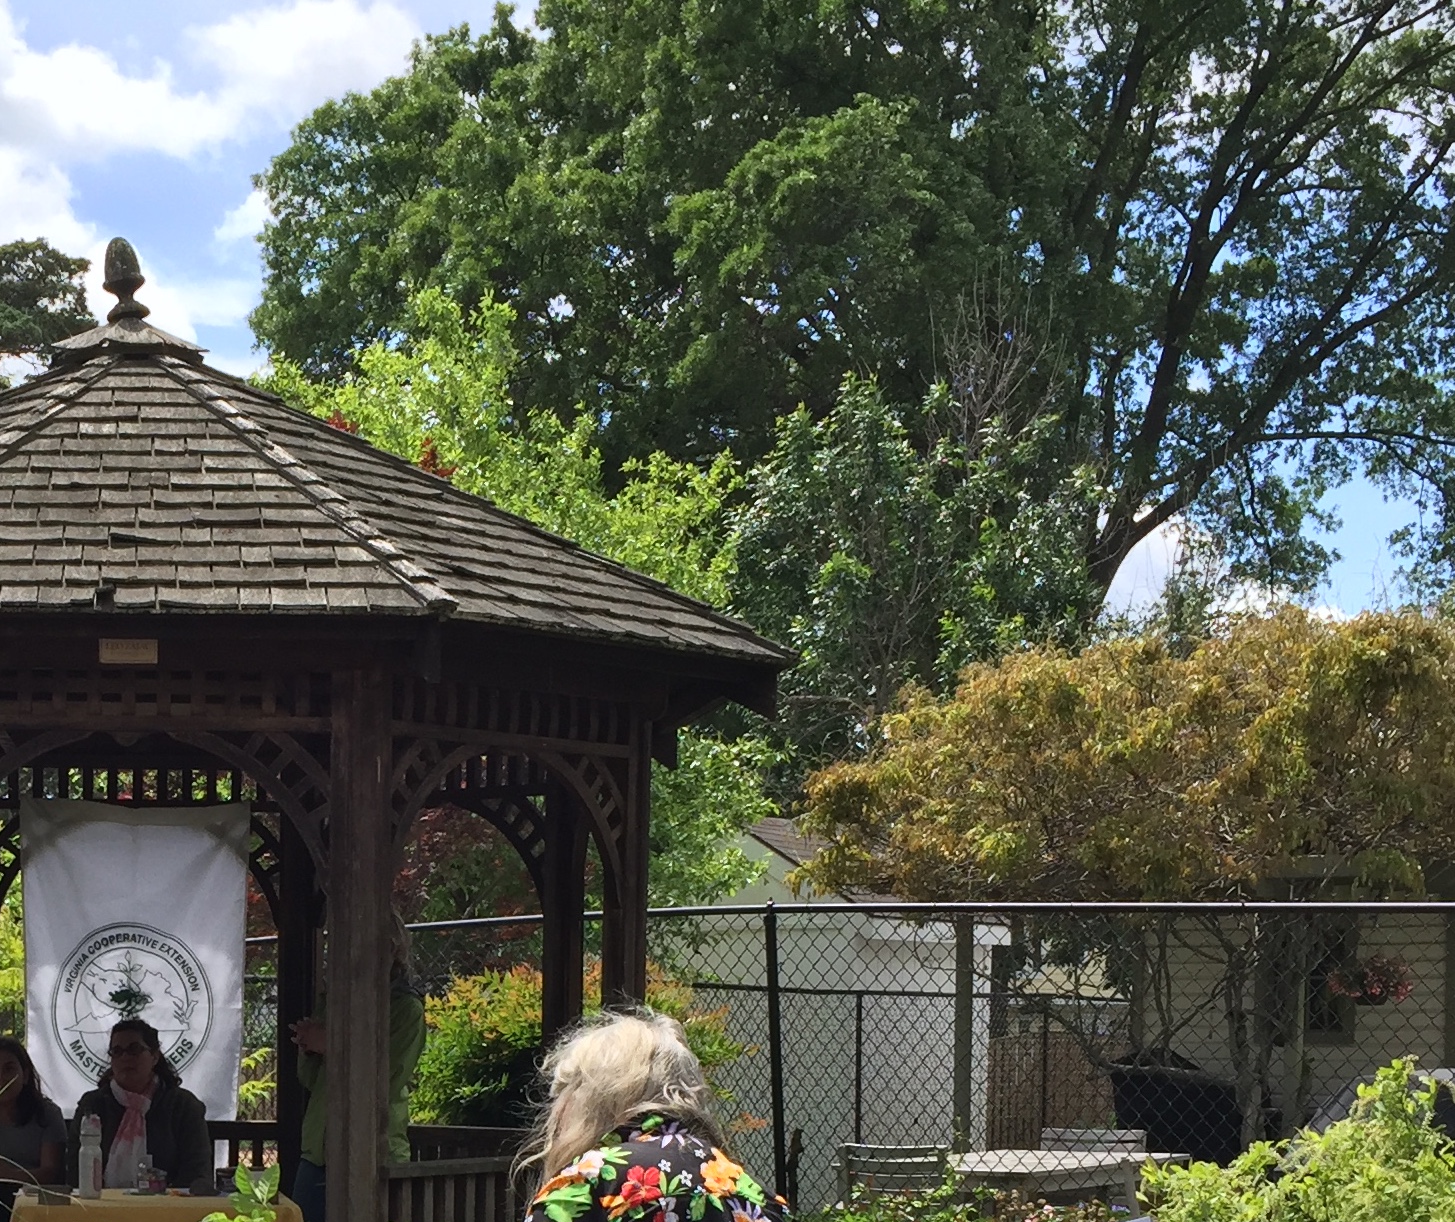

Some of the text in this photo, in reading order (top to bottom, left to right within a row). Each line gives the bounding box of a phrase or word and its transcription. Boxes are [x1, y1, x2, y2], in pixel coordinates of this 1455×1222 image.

[64, 933, 200, 993] VIRGINIA COOPERATIVE EXTENSION
[69, 1039, 106, 1077] MASTE
